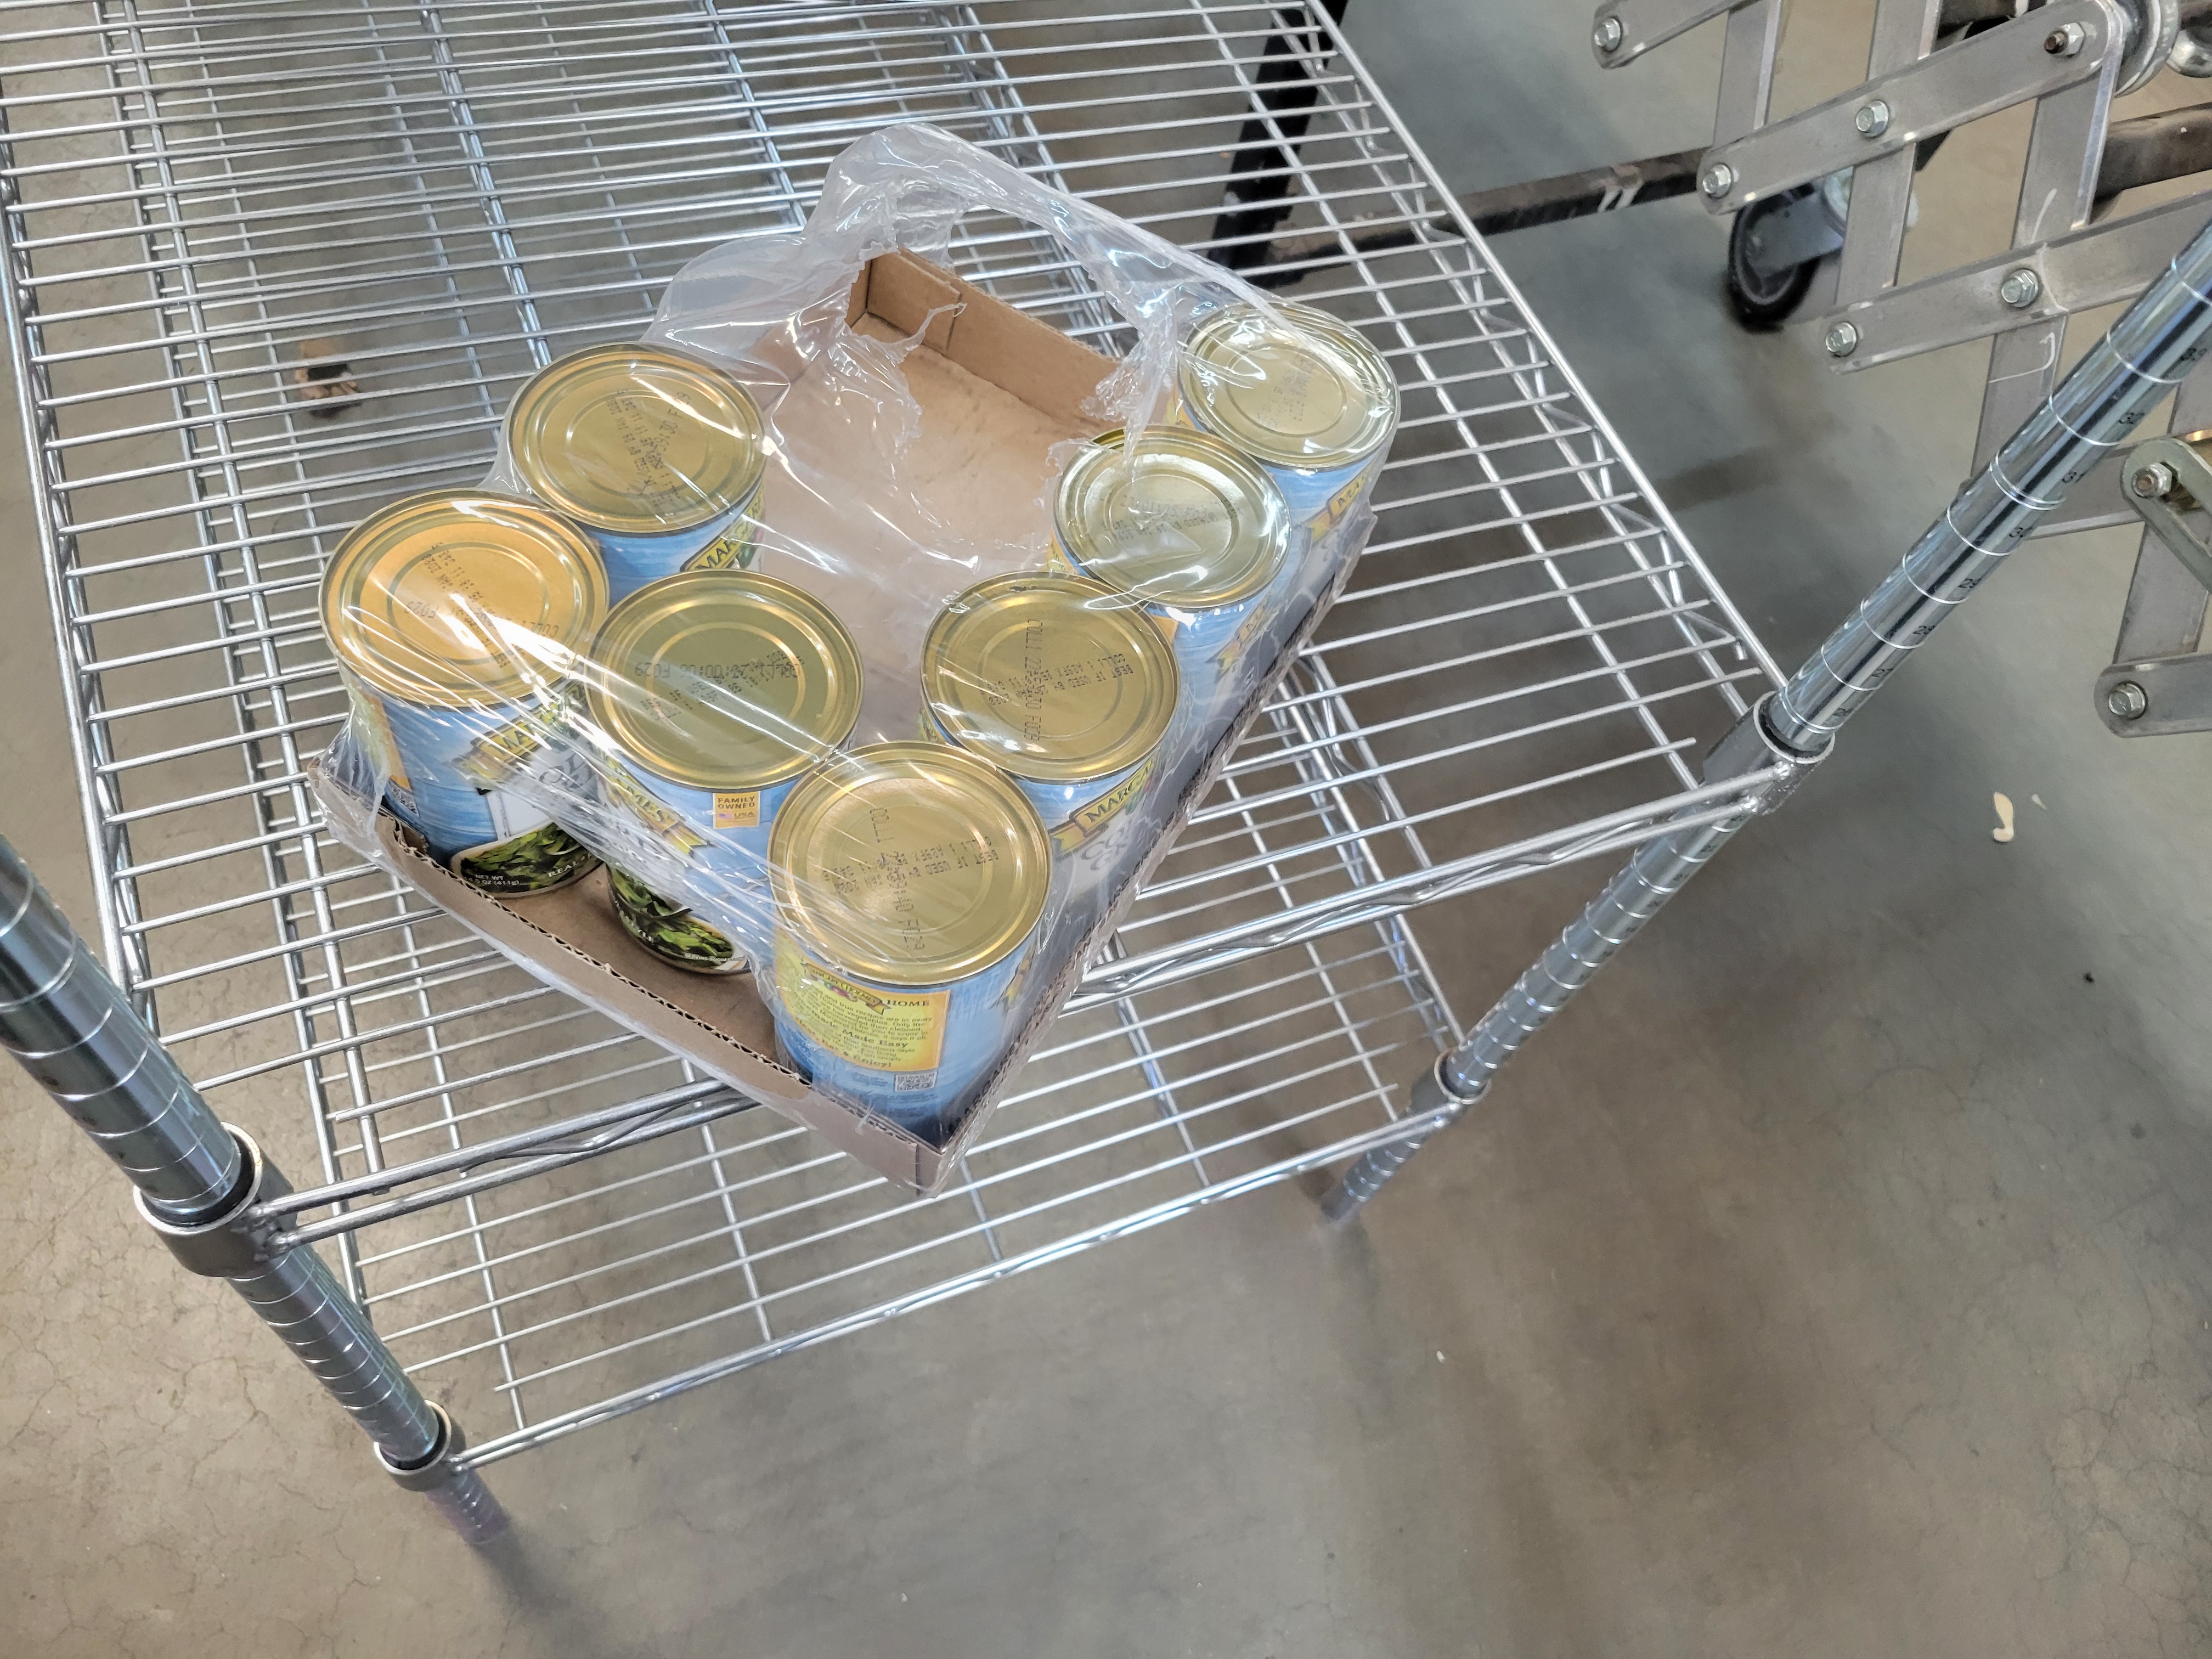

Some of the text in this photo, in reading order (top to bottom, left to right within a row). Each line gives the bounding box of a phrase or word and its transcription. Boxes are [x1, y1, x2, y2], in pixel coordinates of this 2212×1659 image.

[733, 811, 755, 820] USA
[924, 860, 951, 876] USED
[956, 855, 968, 868] IF
[549, 860, 578, 878] REAL
[879, 1040, 909, 1048] Easy
